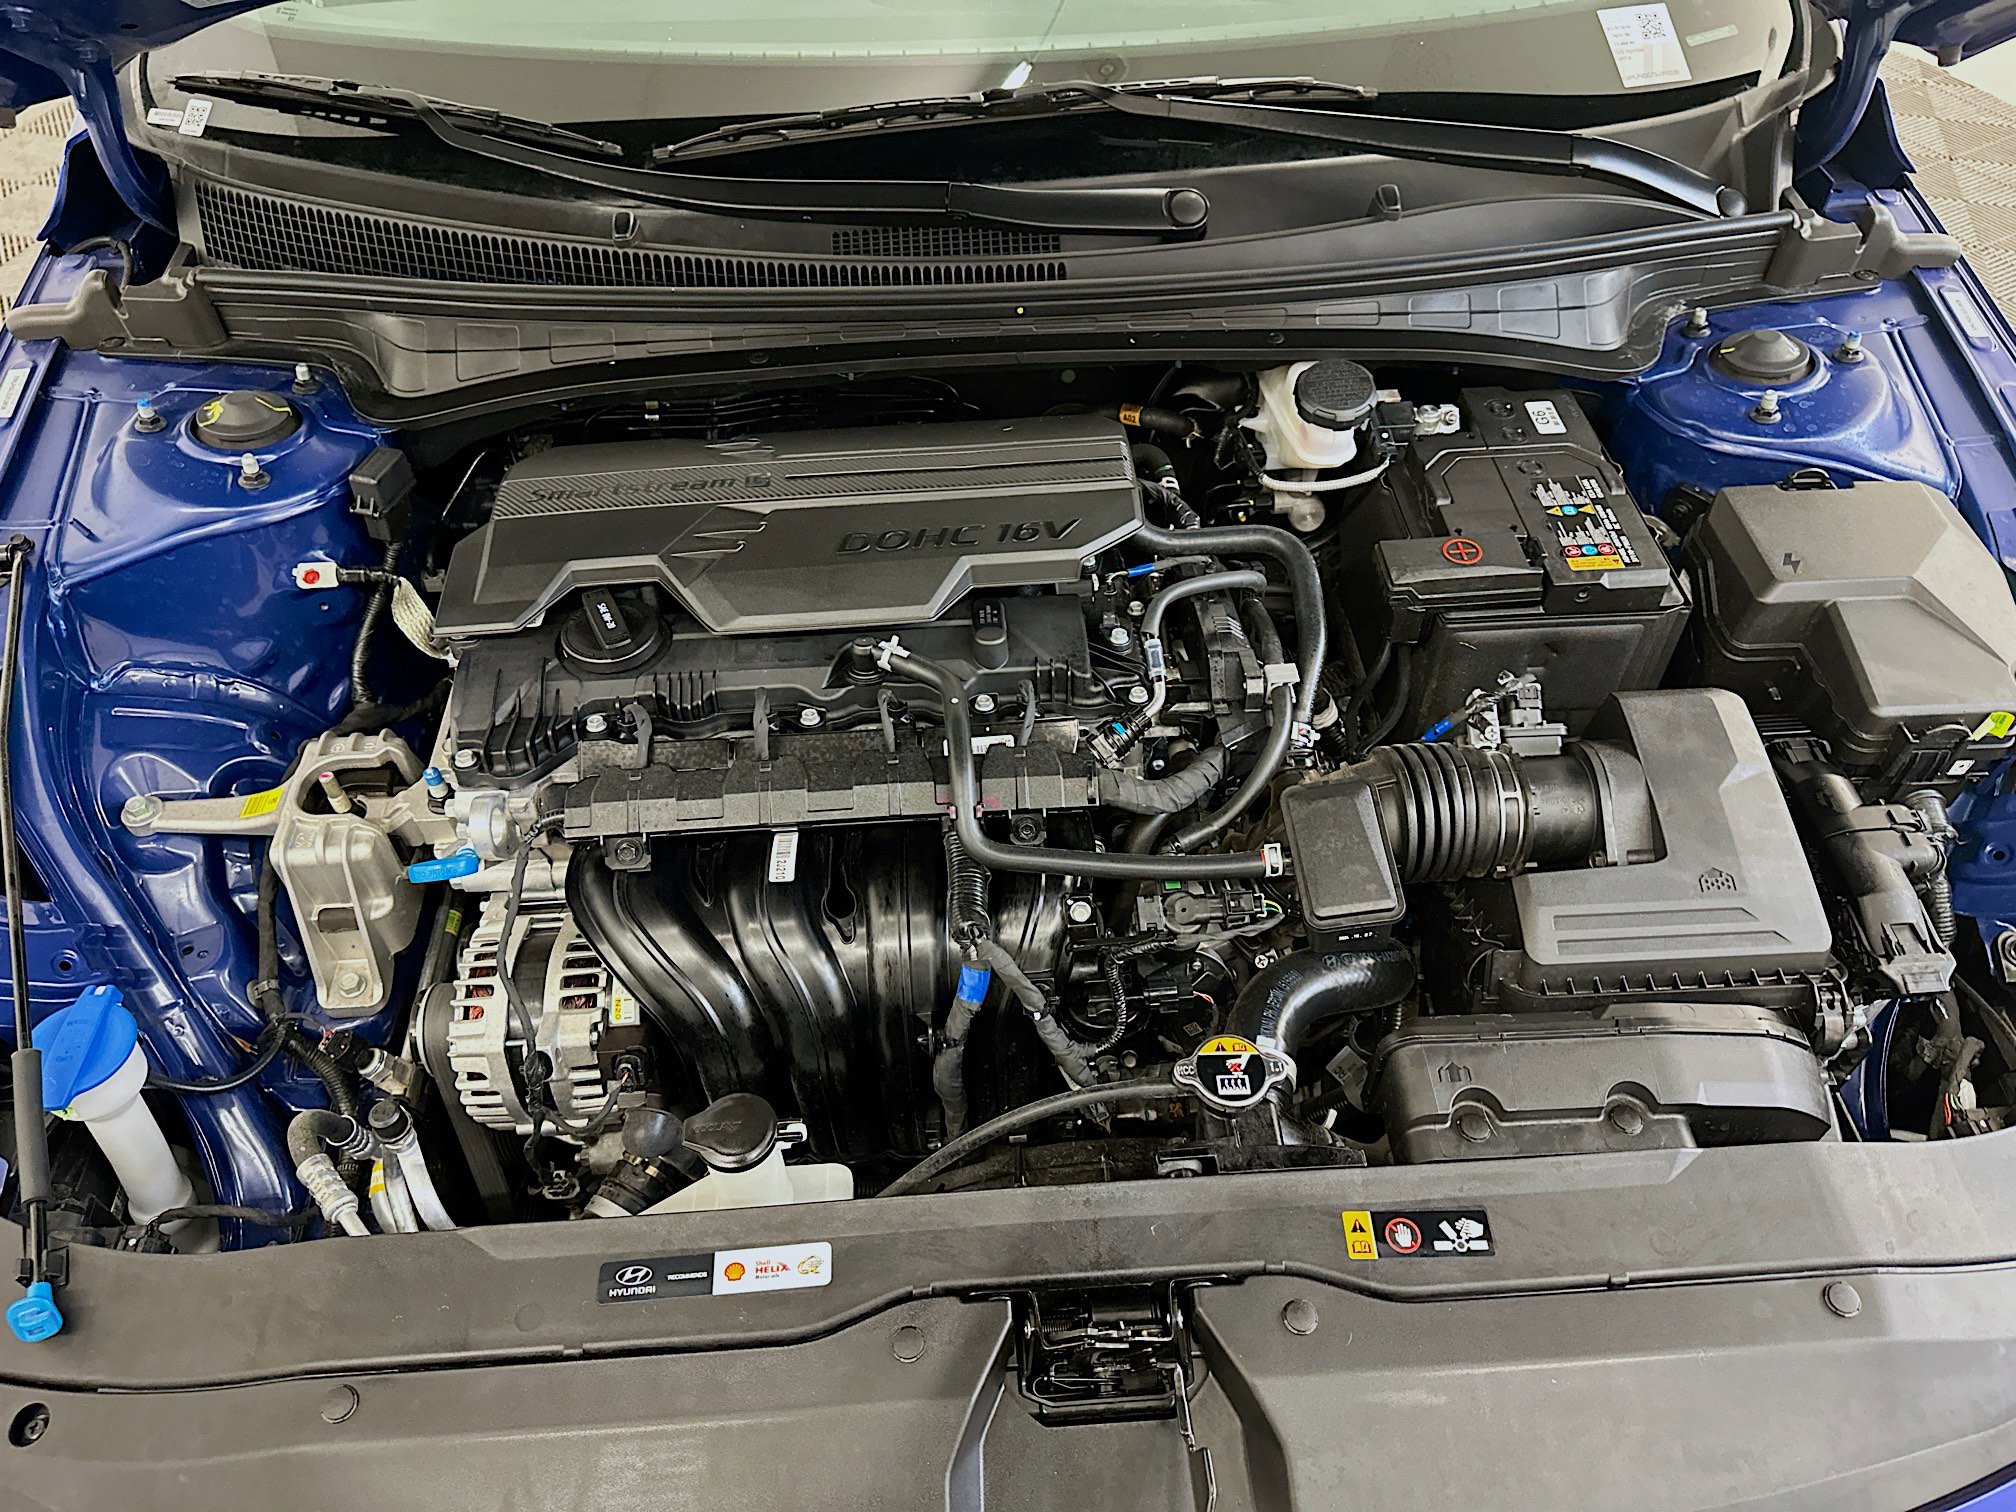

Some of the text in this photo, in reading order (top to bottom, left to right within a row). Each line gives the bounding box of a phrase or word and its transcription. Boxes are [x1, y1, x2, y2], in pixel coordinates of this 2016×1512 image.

[528, 478, 736, 502] Smartstream
[837, 518, 1082, 554] DOHC 16V
[754, 1262, 791, 1274] HELIX
[667, 1271, 708, 1281] RECOMMENDS
[608, 1285, 656, 1298] HYUNDAI
